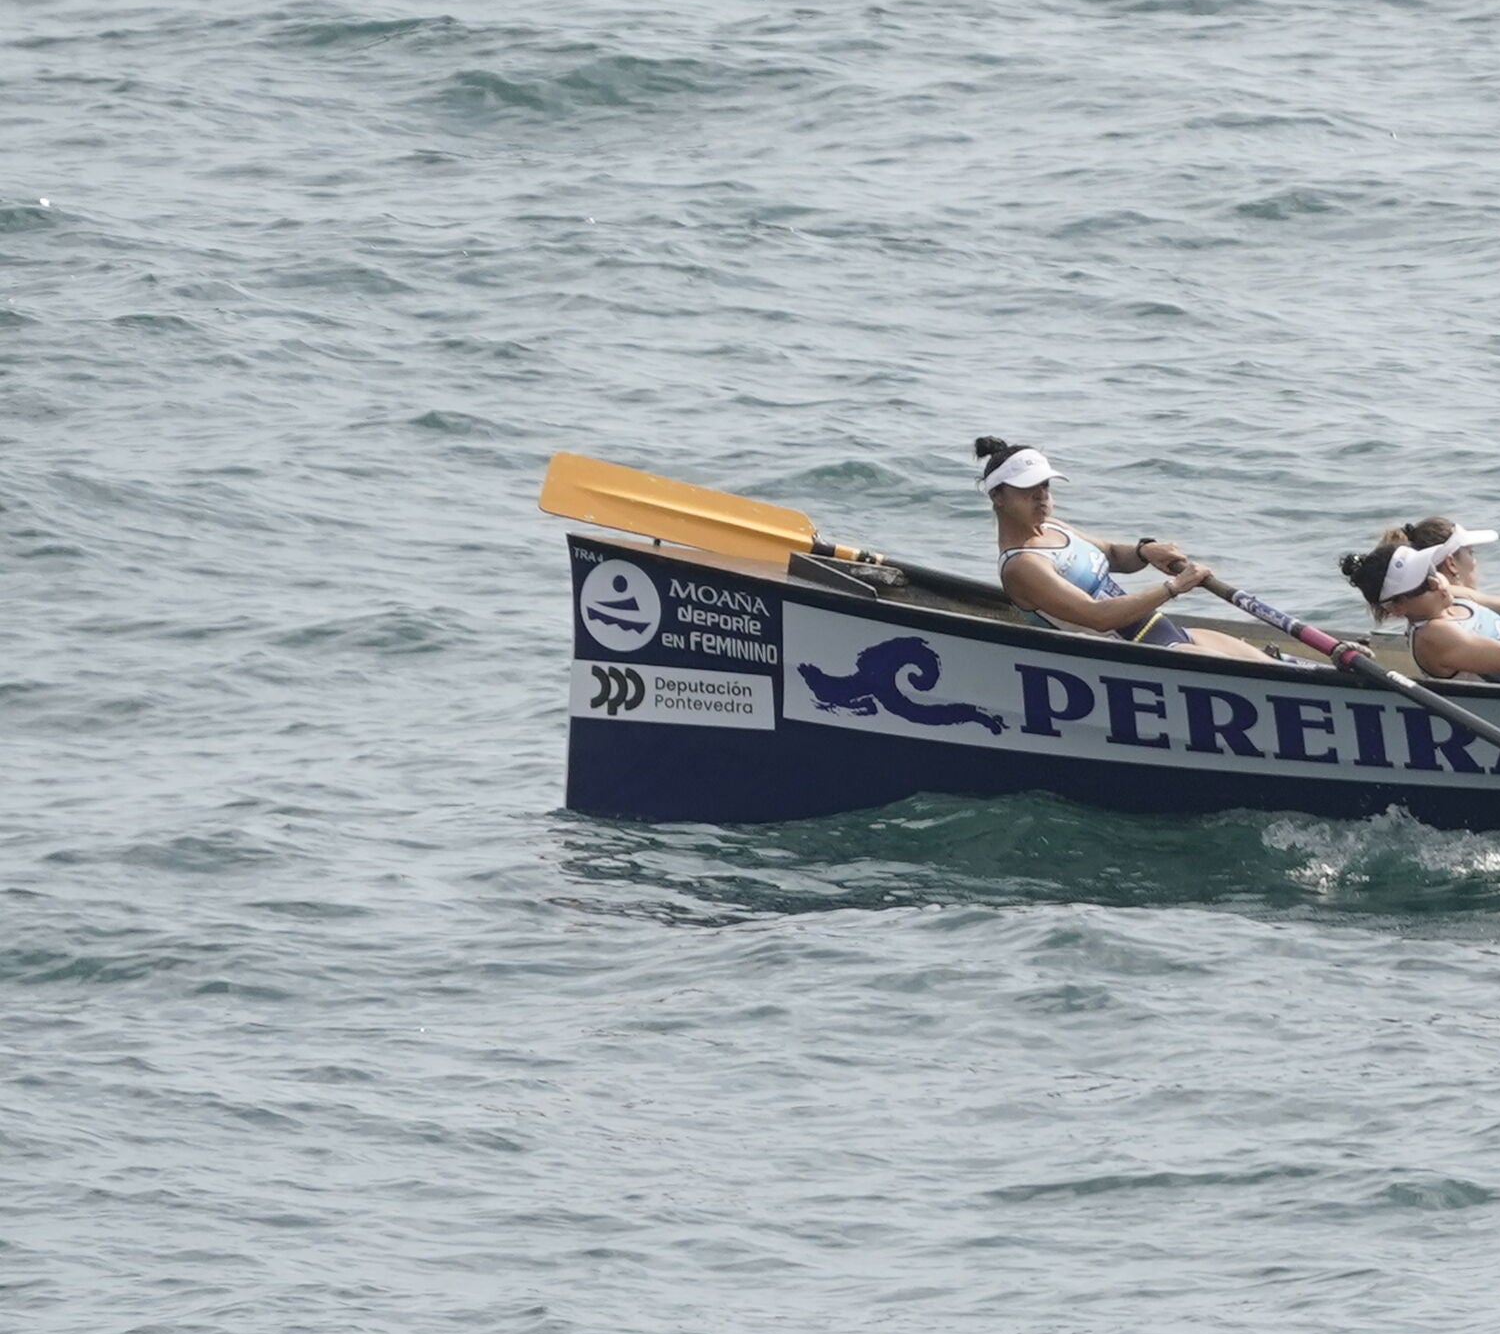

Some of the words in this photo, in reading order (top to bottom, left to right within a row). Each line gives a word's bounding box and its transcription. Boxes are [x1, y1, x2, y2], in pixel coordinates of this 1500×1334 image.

[668, 578, 770, 617] MOAÑA
[654, 676, 753, 699] Deputación
[654, 695, 754, 714] Pontevedra
